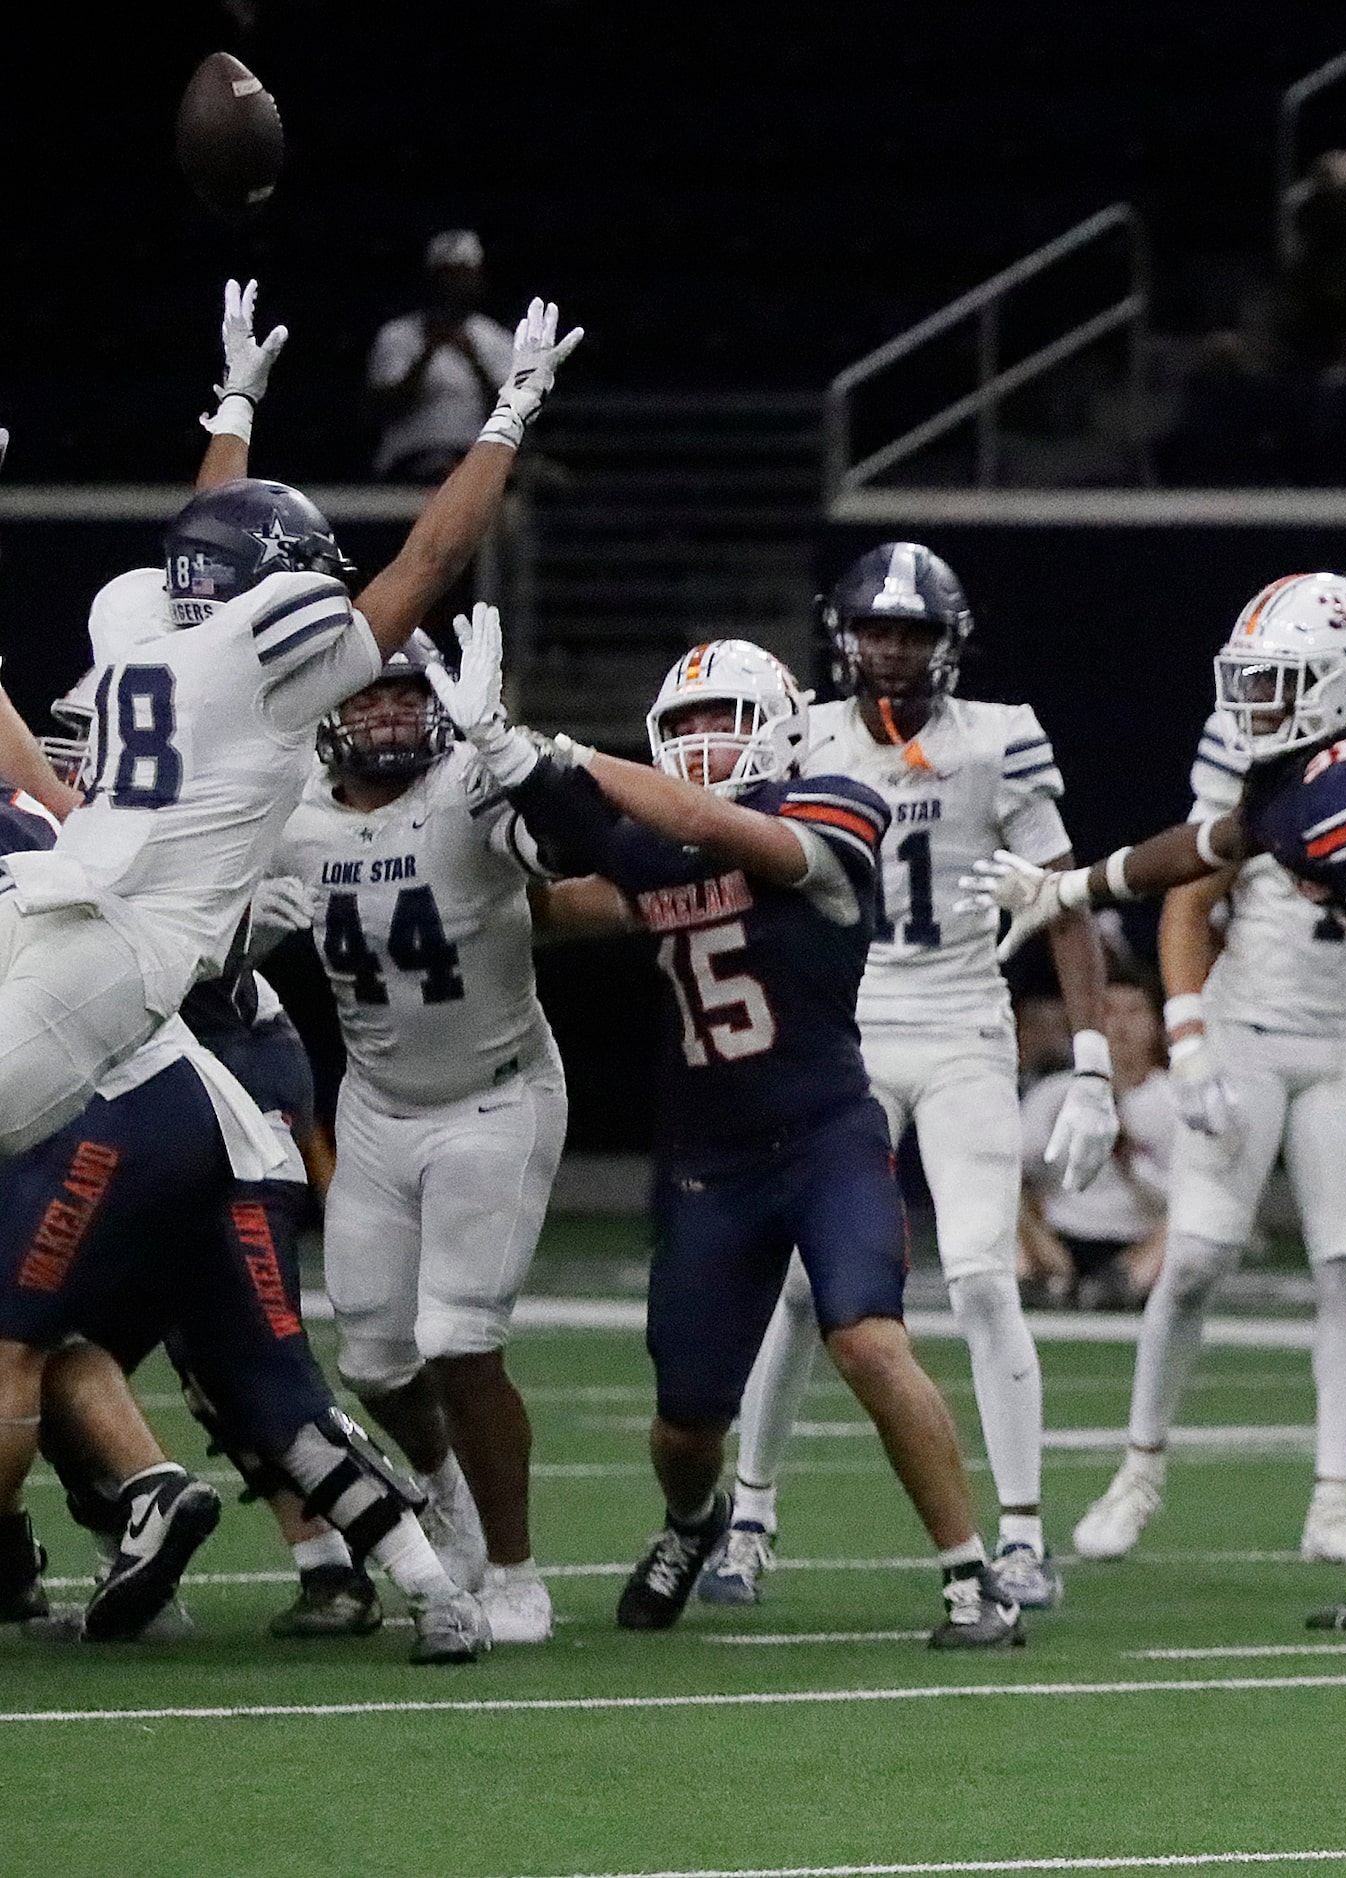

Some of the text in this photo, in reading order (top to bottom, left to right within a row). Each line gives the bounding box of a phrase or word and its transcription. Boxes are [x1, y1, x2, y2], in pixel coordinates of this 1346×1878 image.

[86, 663, 184, 811] 18
[322, 854, 416, 885] LONE STAR
[897, 799, 941, 822] STAR
[323, 882, 466, 1006] 44
[656, 920, 777, 1067] 15
